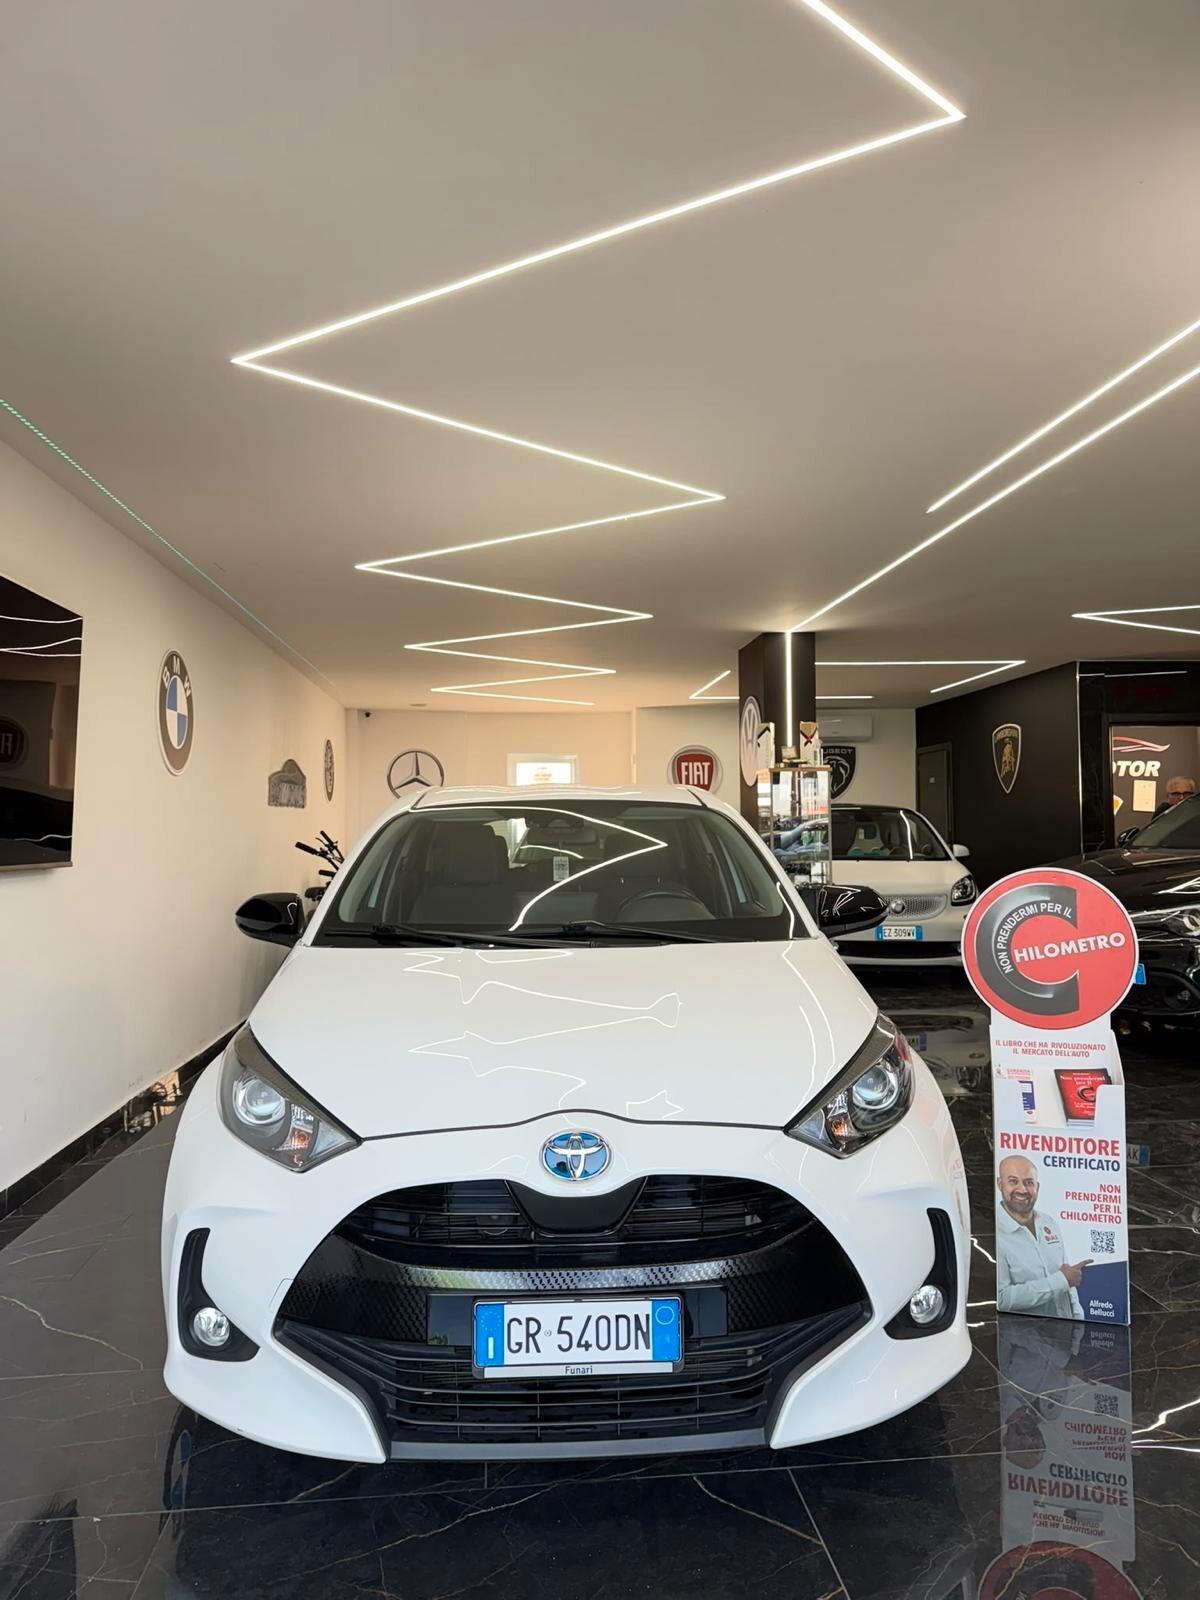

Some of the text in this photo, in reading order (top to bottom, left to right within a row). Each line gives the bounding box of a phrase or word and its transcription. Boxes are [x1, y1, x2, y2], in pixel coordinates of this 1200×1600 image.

[163, 655, 191, 697] BMW
[681, 762, 711, 785] FIAT
[1112, 760, 1161, 777] TOR
[997, 902, 1072, 974] NON PRENDERMI PER IL
[995, 1039, 1001, 1047] IL
[1051, 1041, 1106, 1051] RIVOLUZIONATO
[1012, 1047, 1019, 1055] IL
[1021, 1048, 1054, 1056] MERCATO
[1000, 1132, 1120, 1157] RIVENDITORE
[1043, 1155, 1121, 1172] CERTIFICATO
[1099, 1183, 1121, 1194] NON
[1065, 1191, 1121, 1204] PRENDERMI
[1093, 1203, 1122, 1214] PER IL
[1060, 1210, 1122, 1225] CHILOMETRO
[1089, 1299, 1113, 1309] Alfredo
[1089, 1308, 1115, 1318] Bellucci
[506, 1316, 542, 1354] GR
[556, 1313, 651, 1353] 540DN
[565, 1366, 593, 1375] Funari
